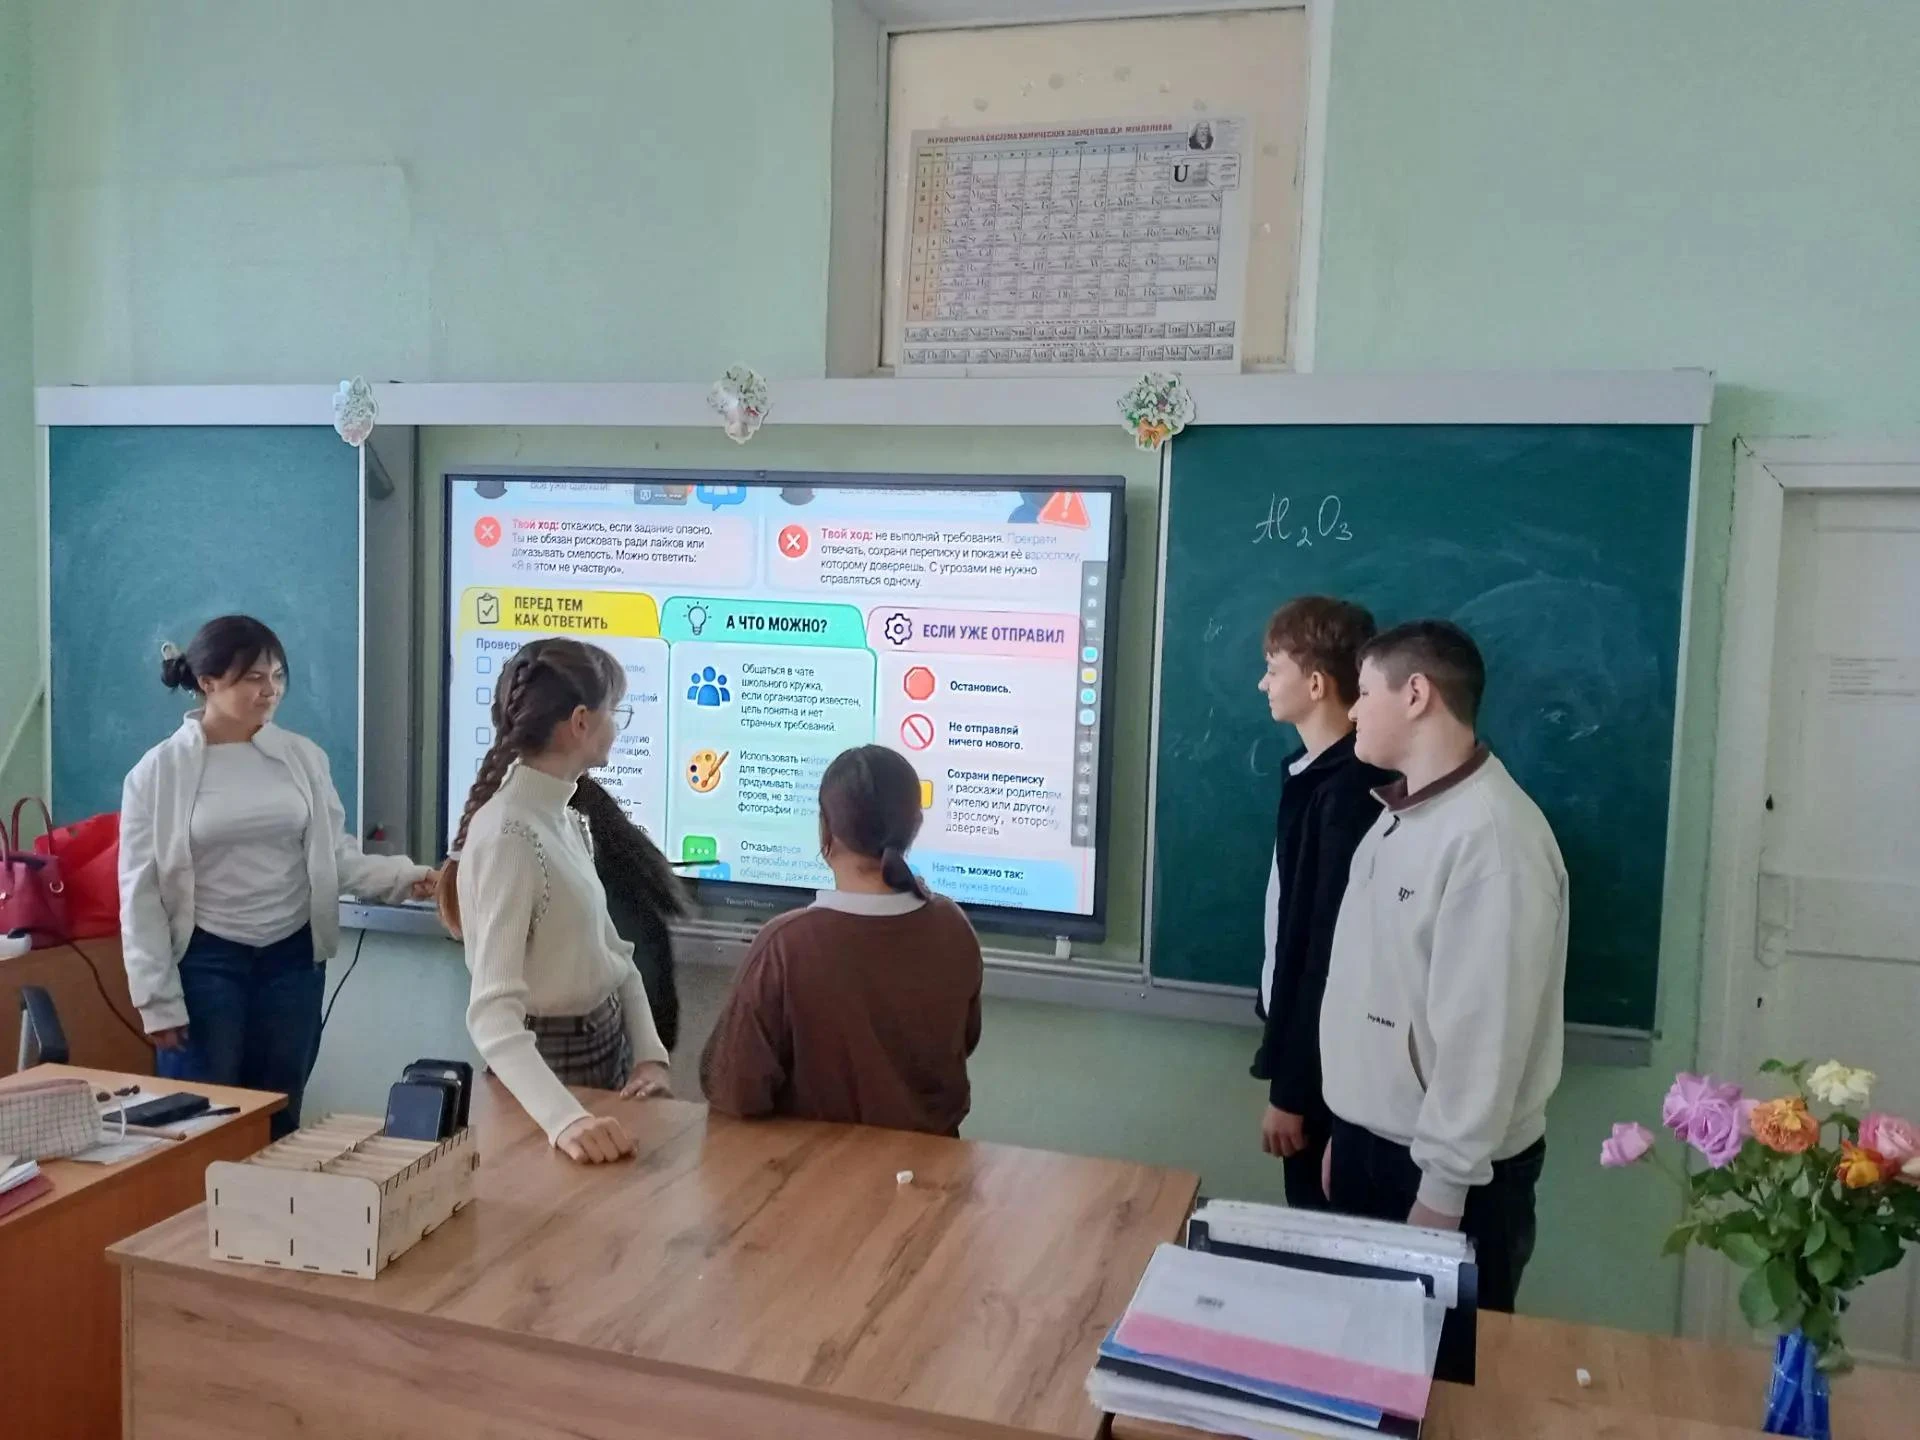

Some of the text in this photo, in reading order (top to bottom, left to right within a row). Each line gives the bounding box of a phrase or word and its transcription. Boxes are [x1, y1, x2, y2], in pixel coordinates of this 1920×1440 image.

[1173, 164, 1189, 183] U
[513, 518, 536, 529] Твой
[538, 521, 559, 532] ход:
[561, 522, 607, 534] откажись,
[610, 523, 632, 533] если
[635, 524, 673, 534] задание
[513, 533, 704, 549] Ты не обязан рисковать ради лайков или
[821, 527, 847, 540] Твой
[849, 529, 873, 542] ход:
[876, 532, 887, 541] не
[890, 531, 940, 544] выполняй
[943, 532, 1004, 546] требования.
[512, 548, 696, 563] доказывать смелость. Можно ответить:
[821, 545, 865, 557] отвечать,
[868, 546, 907, 558] сохрани
[910, 547, 960, 560] переписку
[962, 549, 969, 558] и
[971, 549, 1008, 560] покажи
[1010, 548, 1023, 559] её
[535, 562, 556, 572] этом
[559, 564, 570, 572] не
[572, 564, 624, 576] участвую».
[821, 560, 1038, 576] которому доверяешь. С угрозами не нужно
[820, 574, 881, 587] справляться
[514, 596, 583, 612] ПЕРЕД ТЕМ
[514, 613, 608, 630] КАК ОТВЕТИТЬ
[726, 615, 828, 633] А ЧТО МОЖНО?
[923, 624, 1065, 644] ЕСЛИ УЖЕ ОТПРАВИЛ
[787, 668, 793, 676] в
[795, 668, 815, 677] чате
[741, 678, 823, 692] школьного кружка,
[950, 680, 1012, 694] Остановись.
[741, 691, 862, 707] если организатор известен,
[741, 704, 823, 718] цель понятна и нет
[740, 718, 837, 732] странных требований.
[949, 721, 1019, 736] Не отправляй
[948, 738, 1024, 751] ничего нового.
[740, 750, 799, 764] Использовать
[617, 766, 643, 776] ролик
[739, 765, 755, 774] для
[757, 766, 804, 776] творчества
[947, 768, 1045, 787] Сохрани переписку
[739, 778, 793, 789] придумывать
[947, 784, 954, 792] и
[955, 784, 1004, 797] расскажи
[738, 790, 769, 801] героев,
[771, 793, 782, 801] не
[738, 802, 792, 815] фотографии
[946, 797, 1056, 815] учителю или другому
[945, 824, 1000, 836] доверяешь
[932, 862, 1024, 879] Начать можно так:
